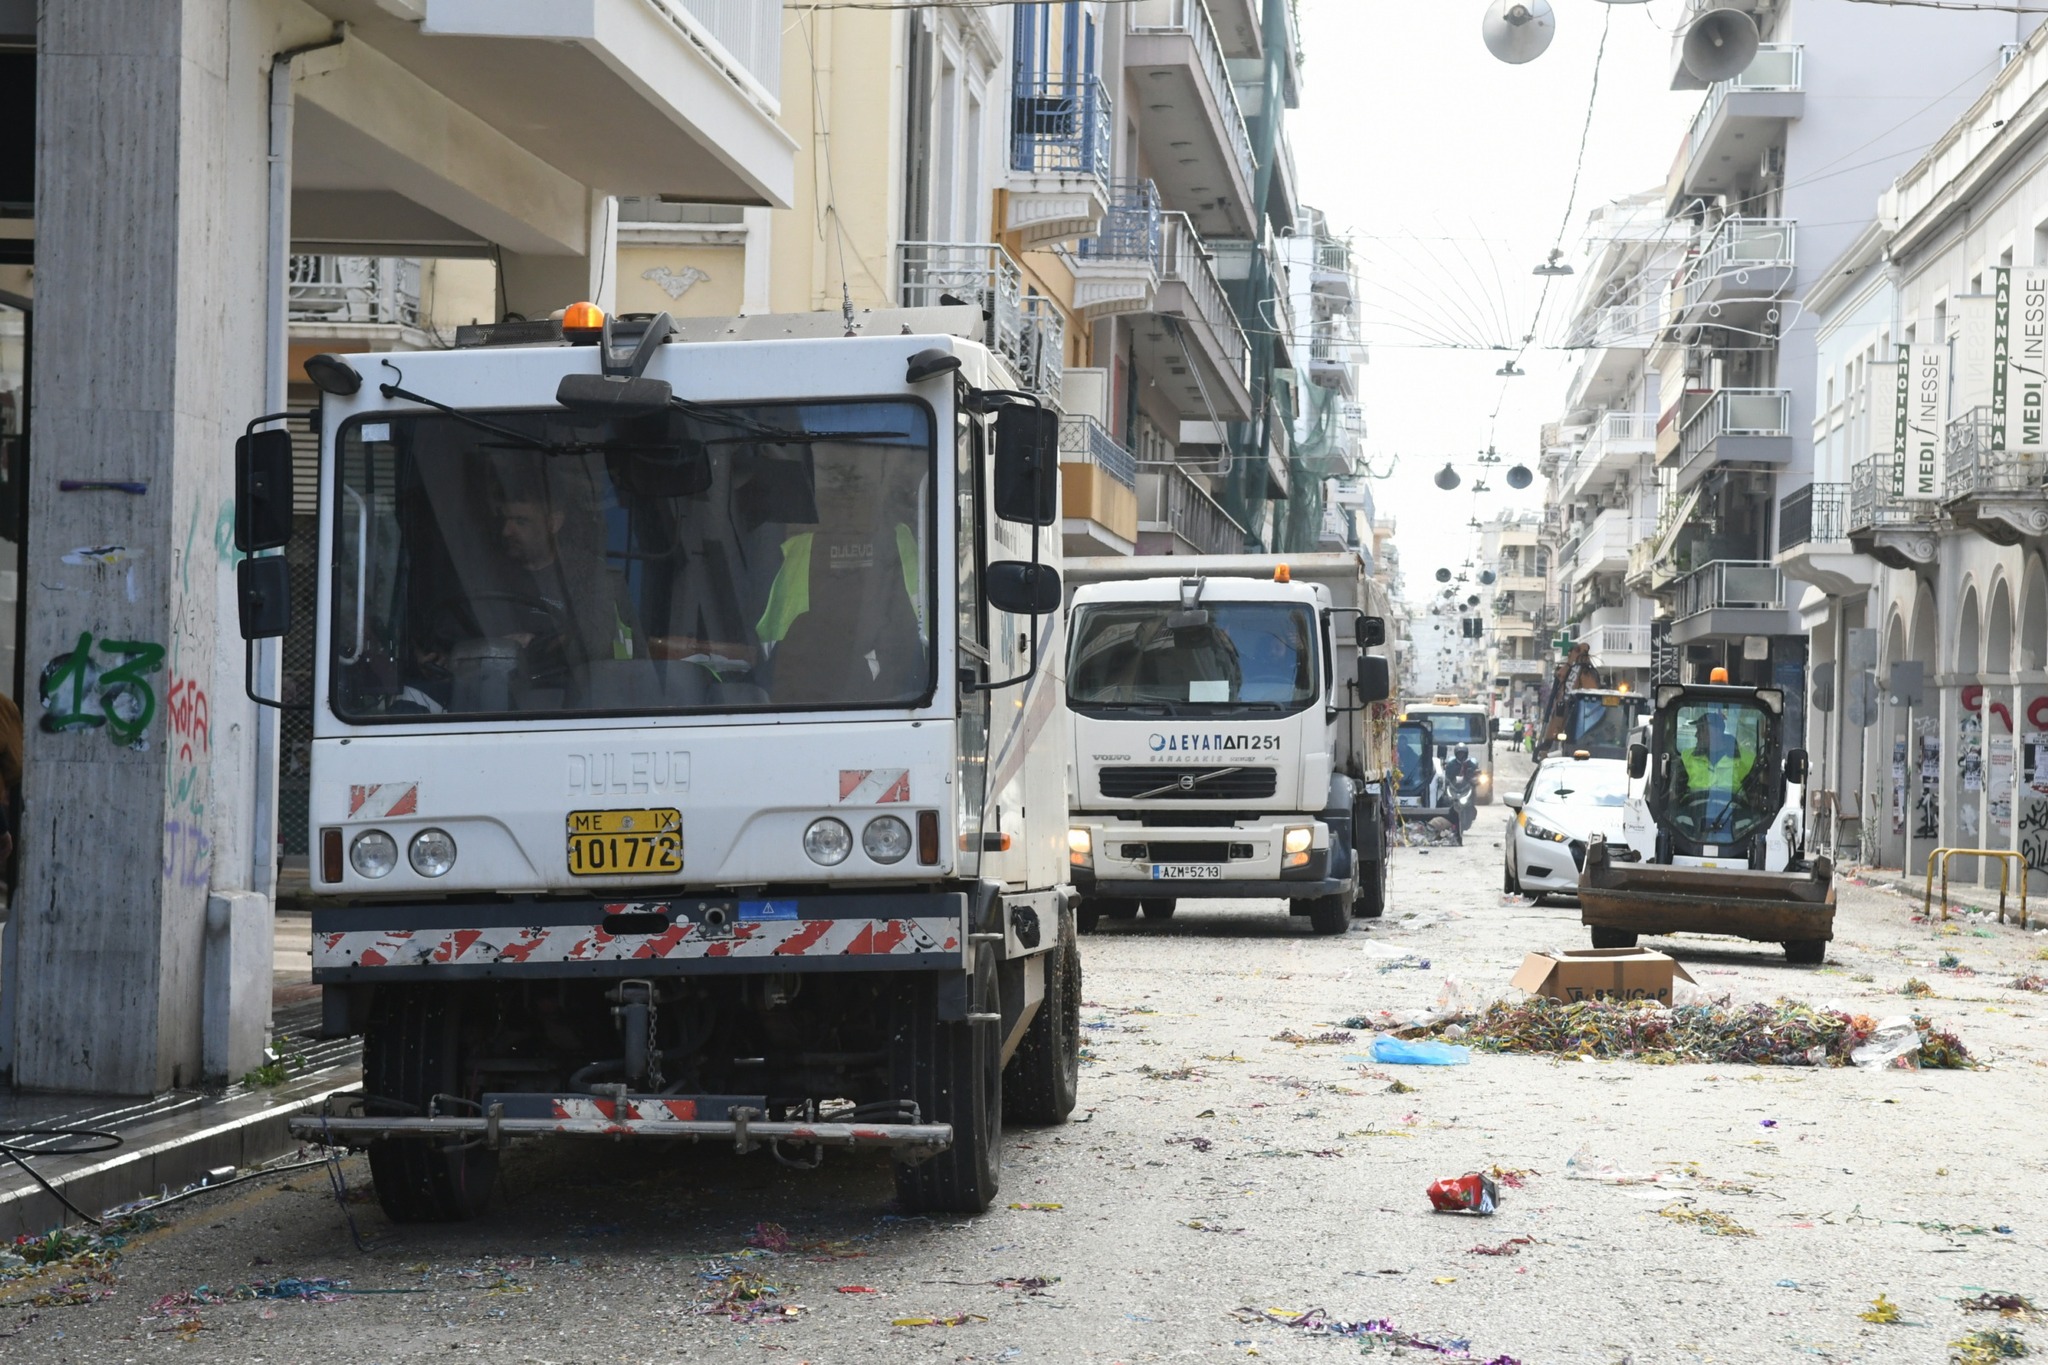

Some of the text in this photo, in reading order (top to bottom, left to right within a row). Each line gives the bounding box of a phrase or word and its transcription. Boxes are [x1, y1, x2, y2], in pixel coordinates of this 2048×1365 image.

[1993, 271, 2009, 444] ΑΔΥΝΑΤΙΣΜΑ
[1893, 348, 1909, 492] ΑΠΟΤΡΙΧΩΣΗ
[1564, 664, 1581, 700] ASE
[1169, 734, 1222, 750] ΔΕΥΑΠ
[576, 815, 602, 830] ME
[574, 837, 675, 869] 101772
